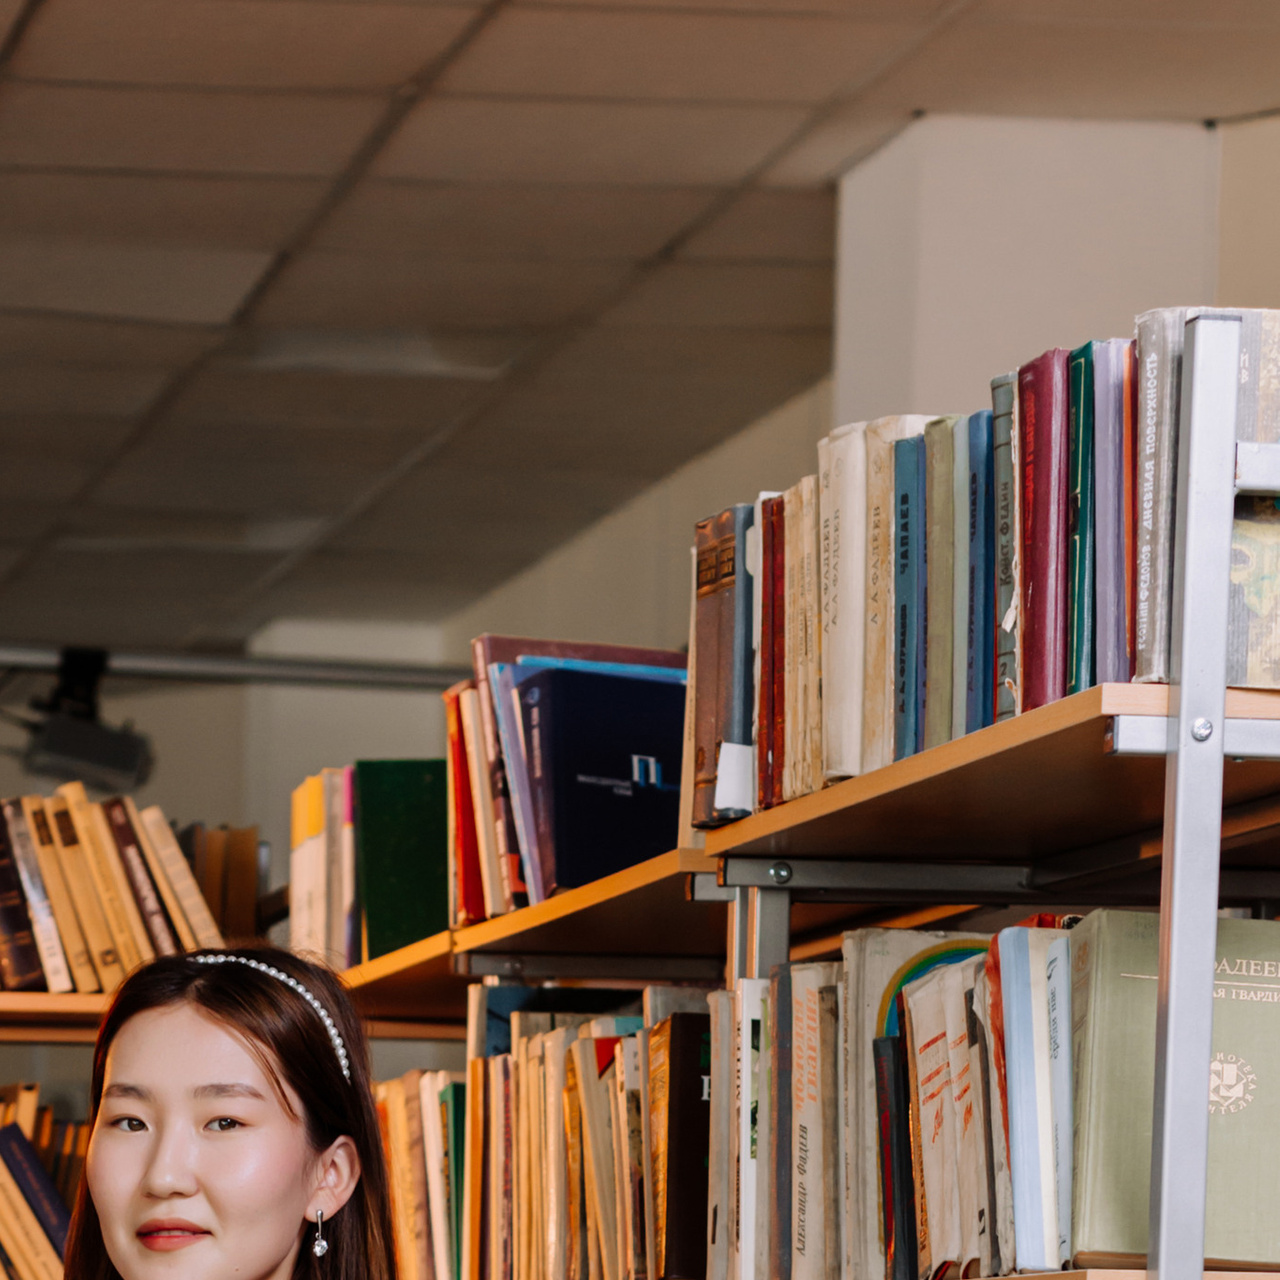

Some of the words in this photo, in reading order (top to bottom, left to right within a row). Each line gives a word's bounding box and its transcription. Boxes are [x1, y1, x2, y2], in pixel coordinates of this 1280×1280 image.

[1144, 352, 1159, 454] ПОВЕРХНОСТЬ
[899, 493, 909, 576] ЧАПАЕВ
[1141, 461, 1155, 532] ДНЕВНАЯ
[1214, 957, 1280, 978] АДЕЕ
